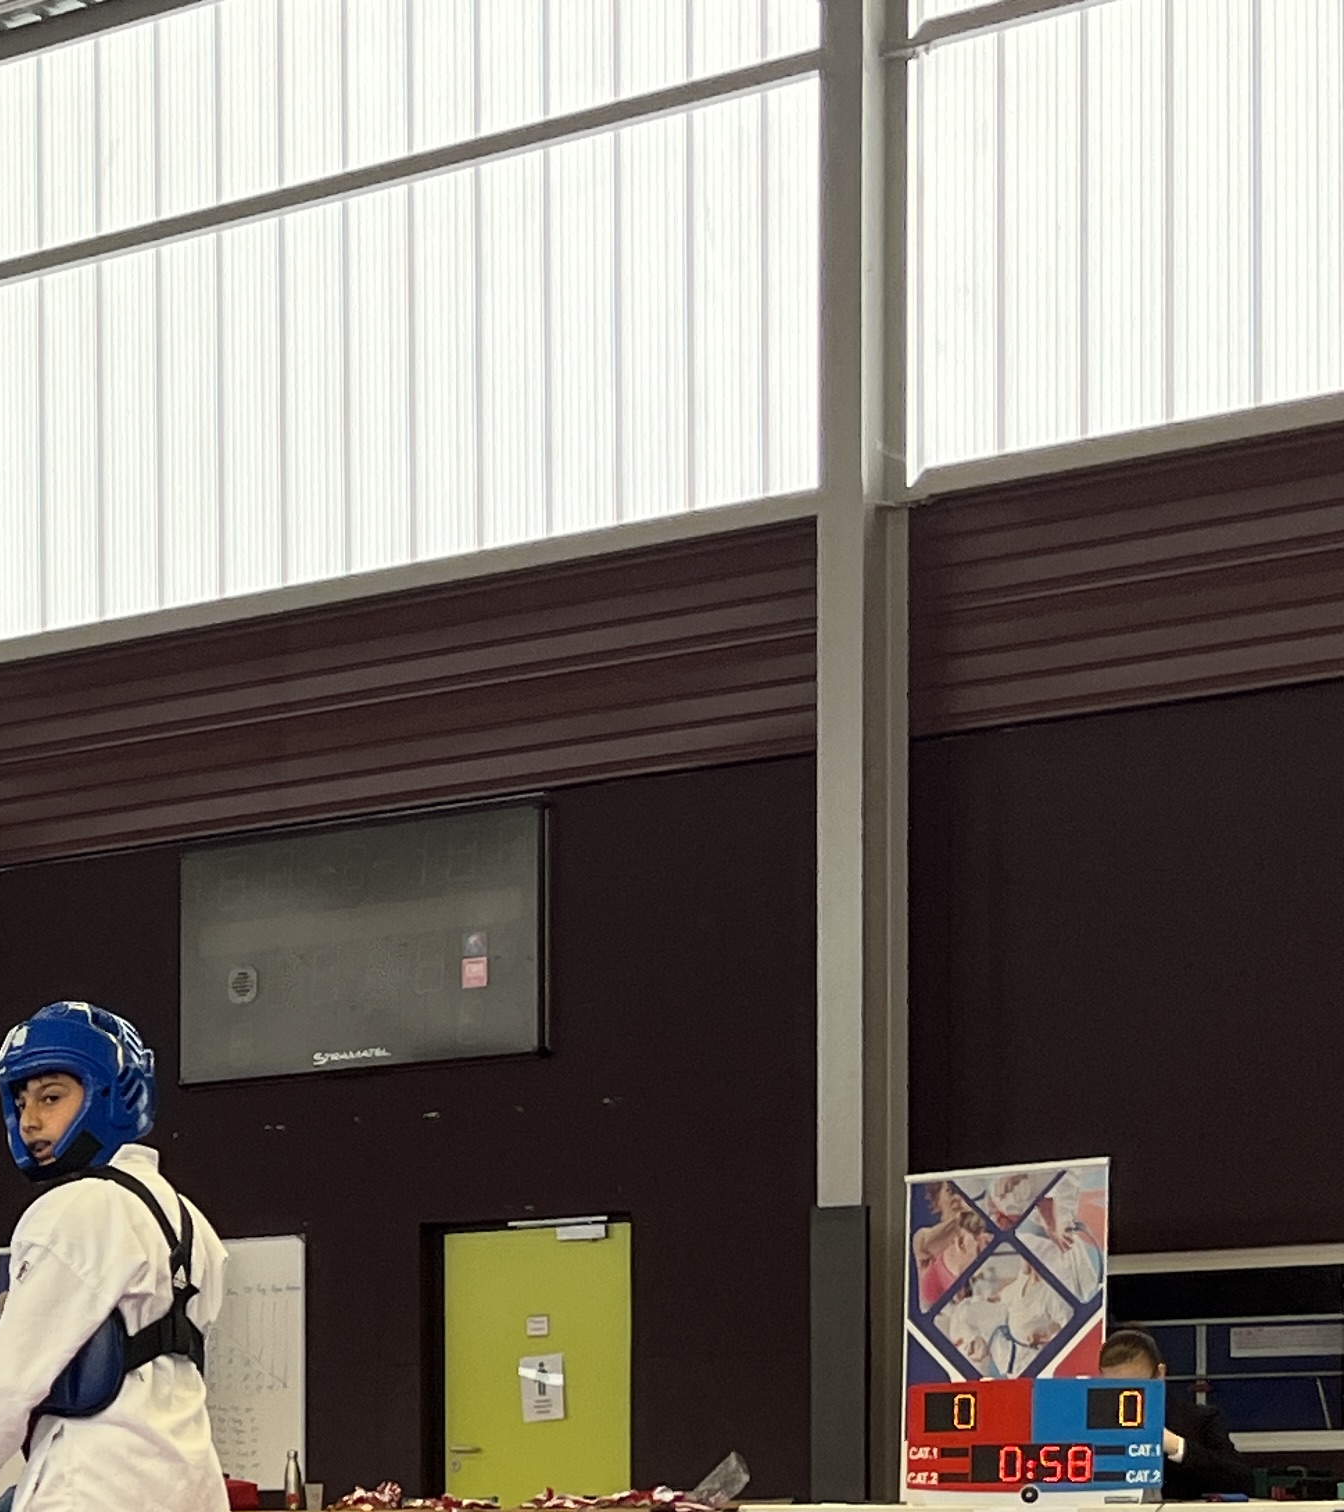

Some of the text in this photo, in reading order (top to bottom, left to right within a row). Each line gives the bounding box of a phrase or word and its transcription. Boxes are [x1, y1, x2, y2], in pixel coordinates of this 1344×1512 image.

[953, 1393, 976, 1429] 0
[1118, 1390, 1143, 1427] 0
[909, 1448, 938, 1459] CAT.1
[1128, 1444, 1161, 1457] CAT.1
[998, 1446, 1093, 1482] 0:58
[907, 1472, 939, 1485] CAT.2
[1125, 1470, 1161, 1483] CAT.2
